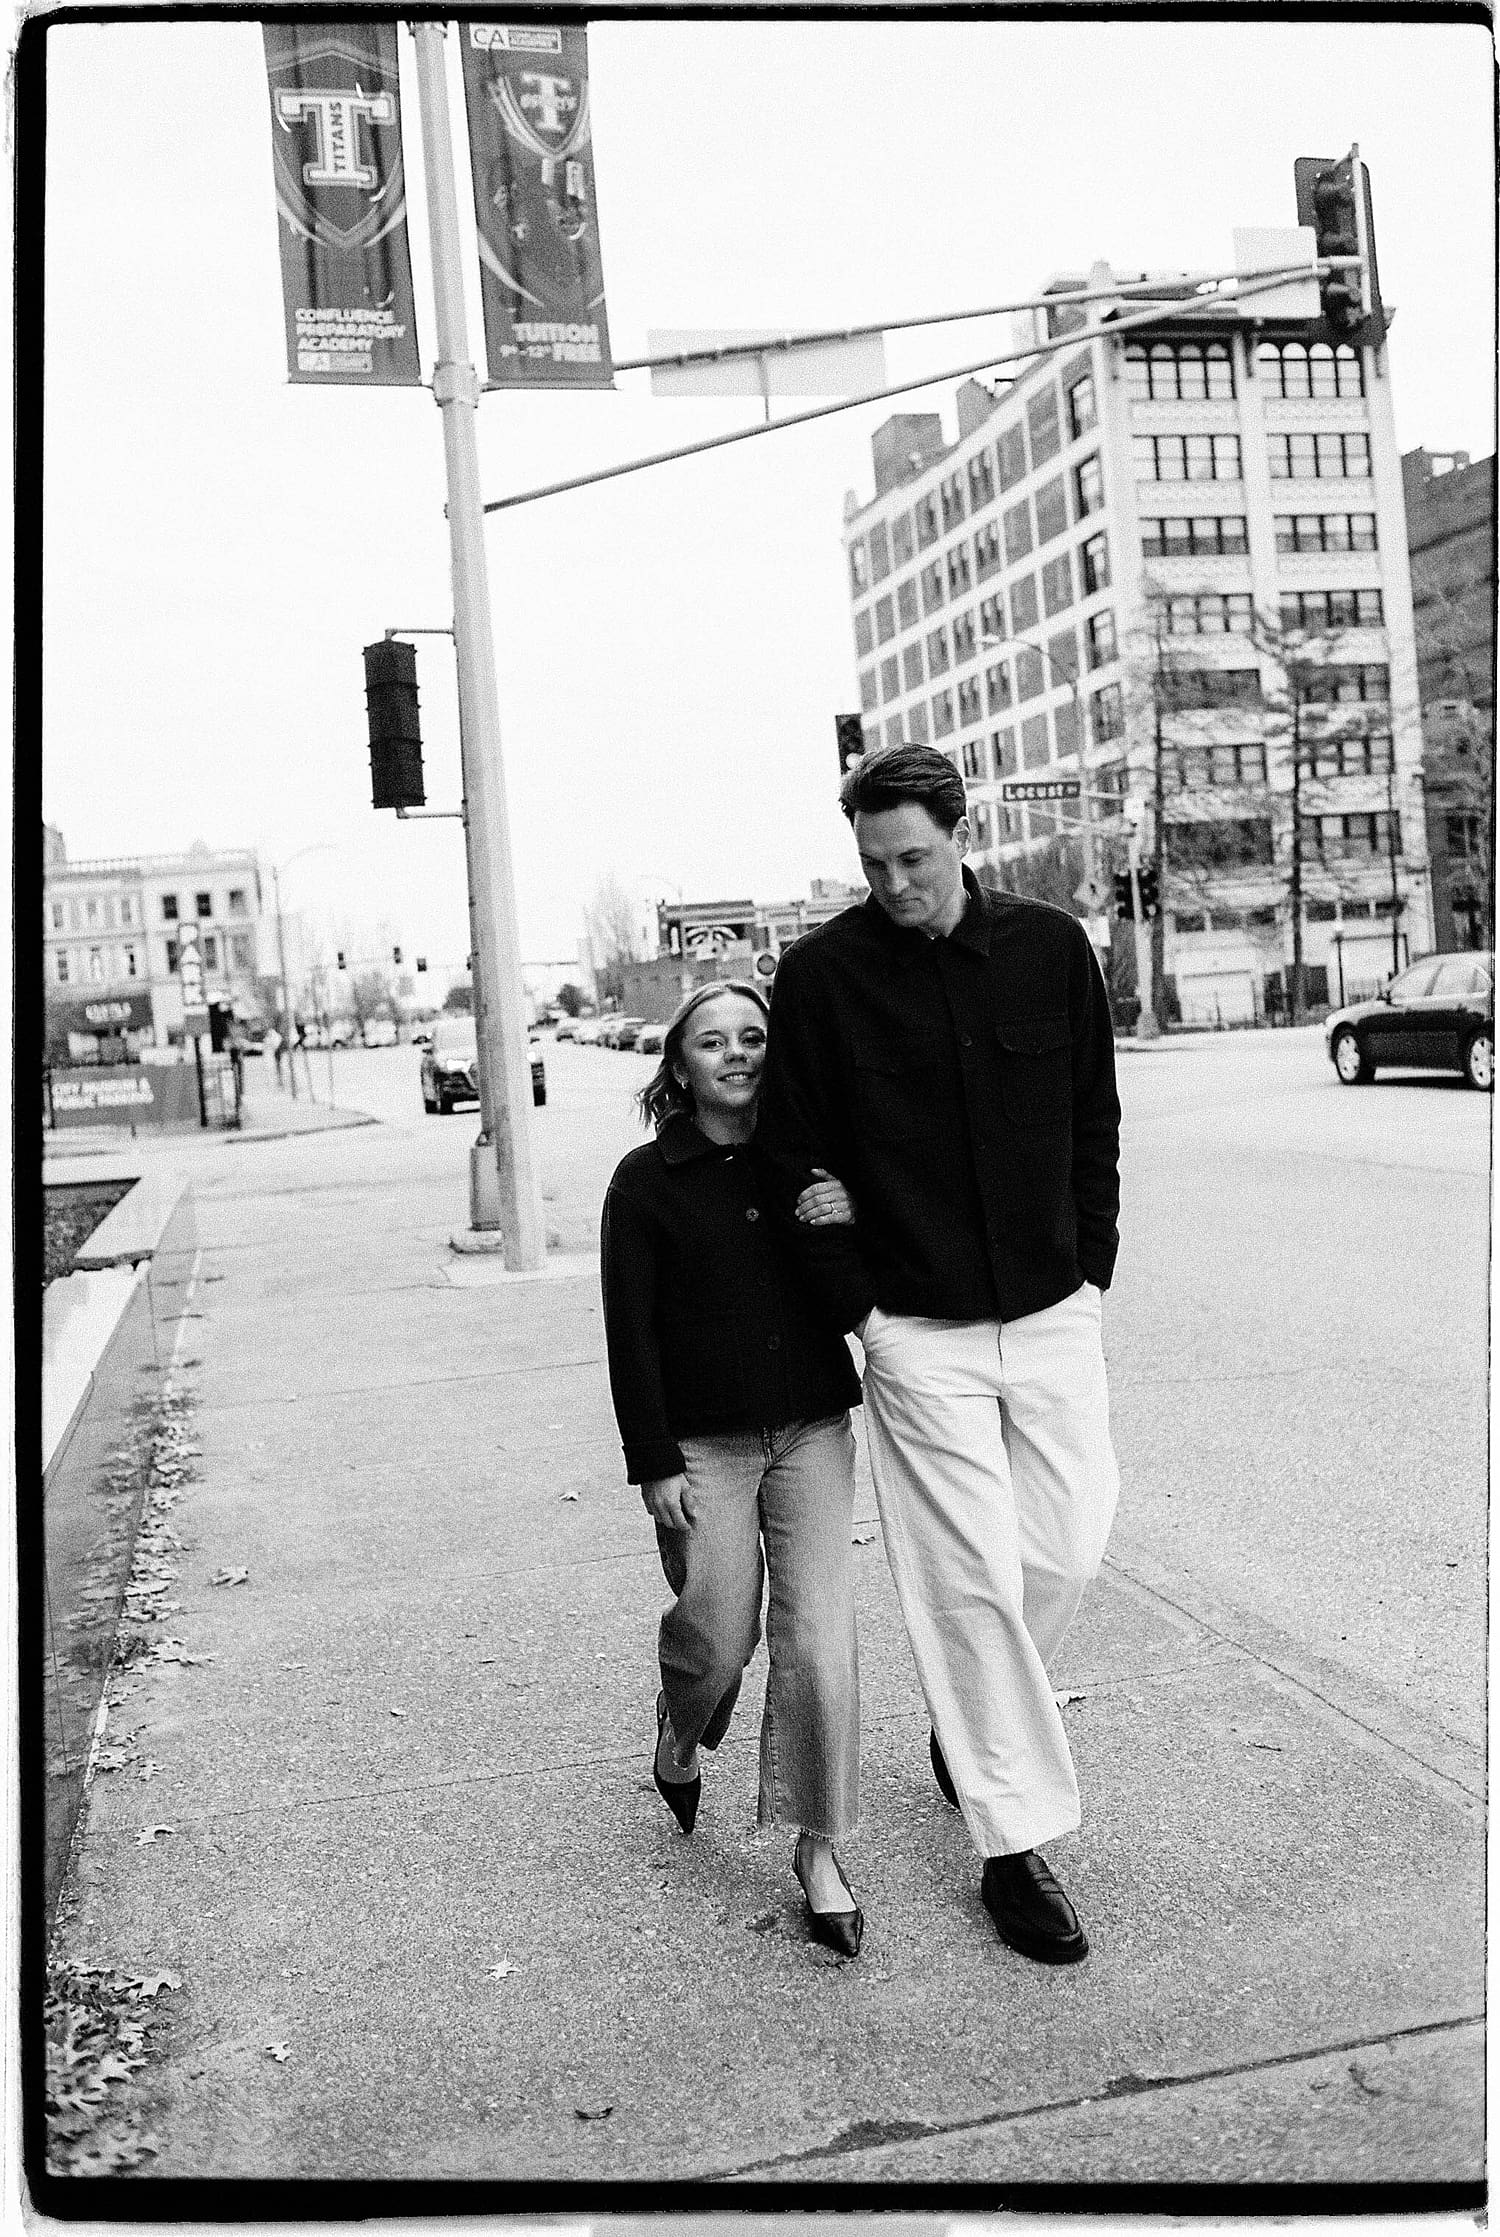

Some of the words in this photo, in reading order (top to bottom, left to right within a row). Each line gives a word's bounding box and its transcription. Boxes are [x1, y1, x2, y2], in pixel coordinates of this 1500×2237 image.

[275, 88, 396, 189] T
[329, 101, 346, 172] TITANS
[295, 308, 394, 324] CONFLUENCE
[296, 322, 406, 339] PREPARATORY
[511, 322, 599, 342] TUITION
[298, 337, 373, 351] ACADEMY
